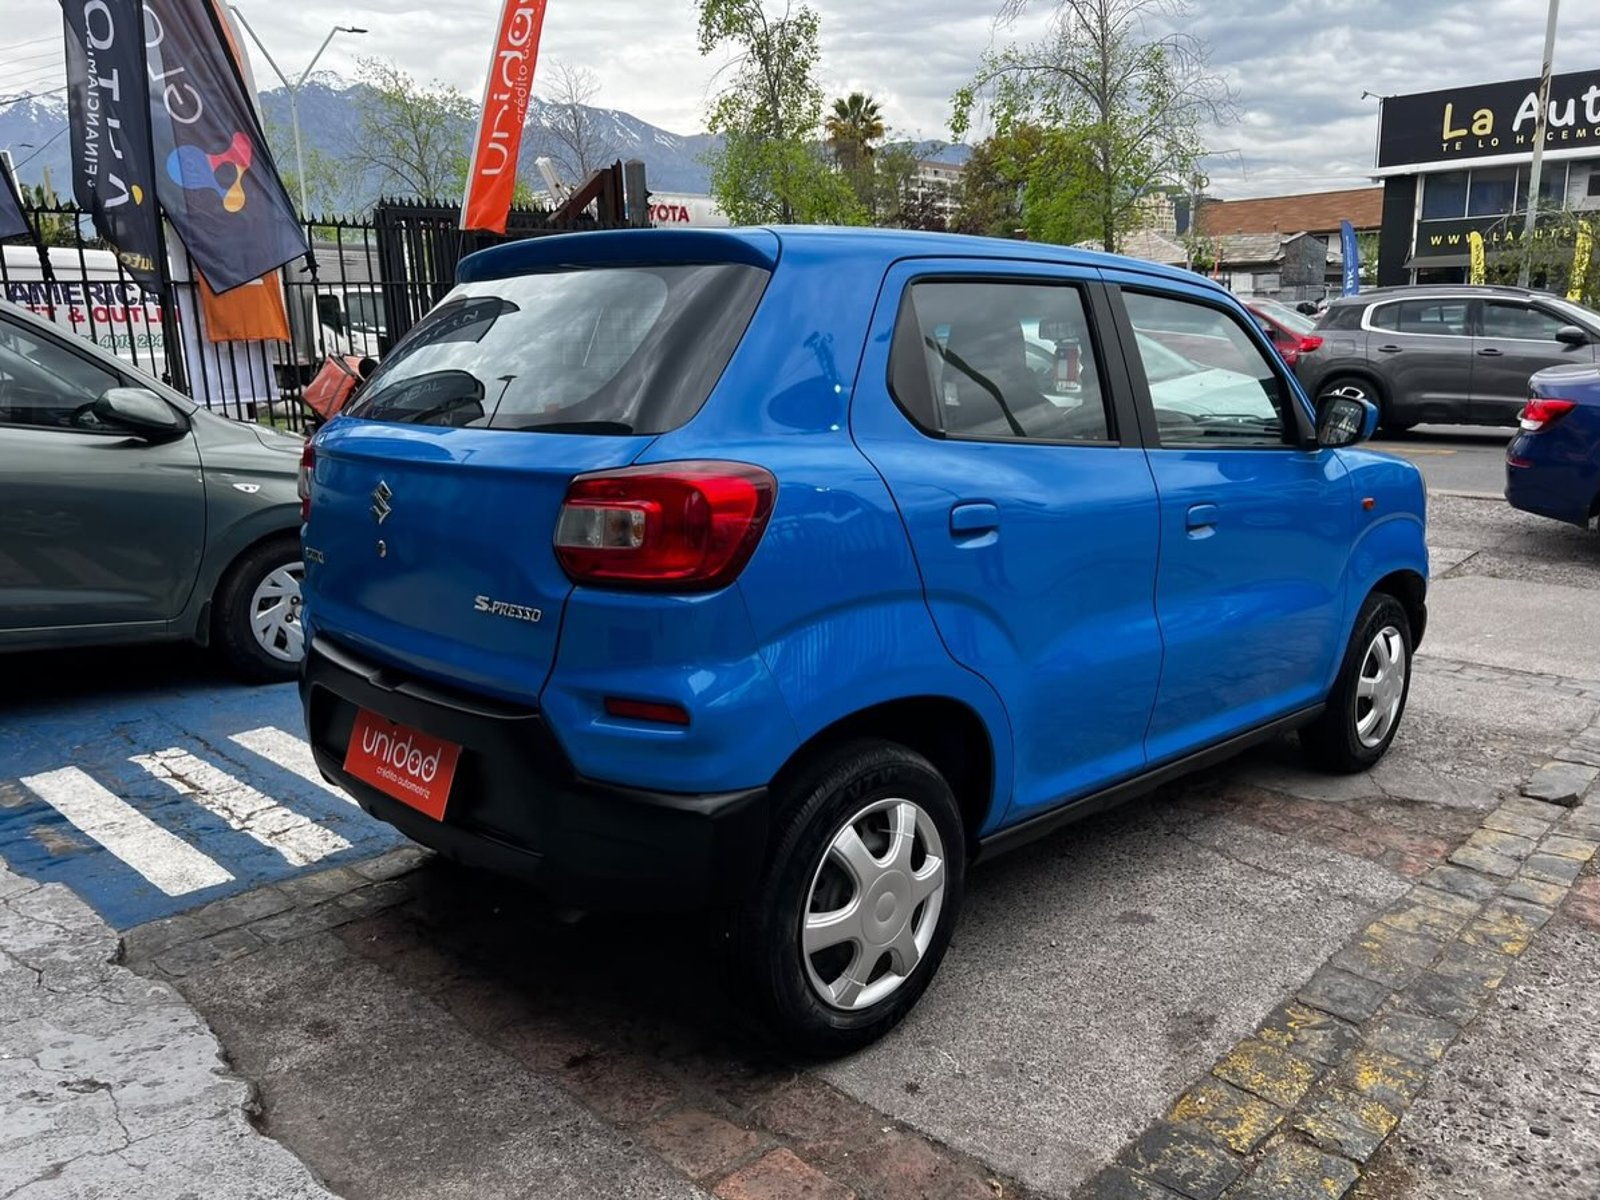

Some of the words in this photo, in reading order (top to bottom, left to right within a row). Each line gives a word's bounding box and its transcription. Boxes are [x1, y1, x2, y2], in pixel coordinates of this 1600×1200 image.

[481, 0, 535, 176] unida
[1442, 102, 1495, 141] La
[1442, 141, 1462, 152] TE
[1478, 137, 1499, 149] LO
[648, 203, 690, 222] YOTA
[362, 726, 442, 782] unidad
